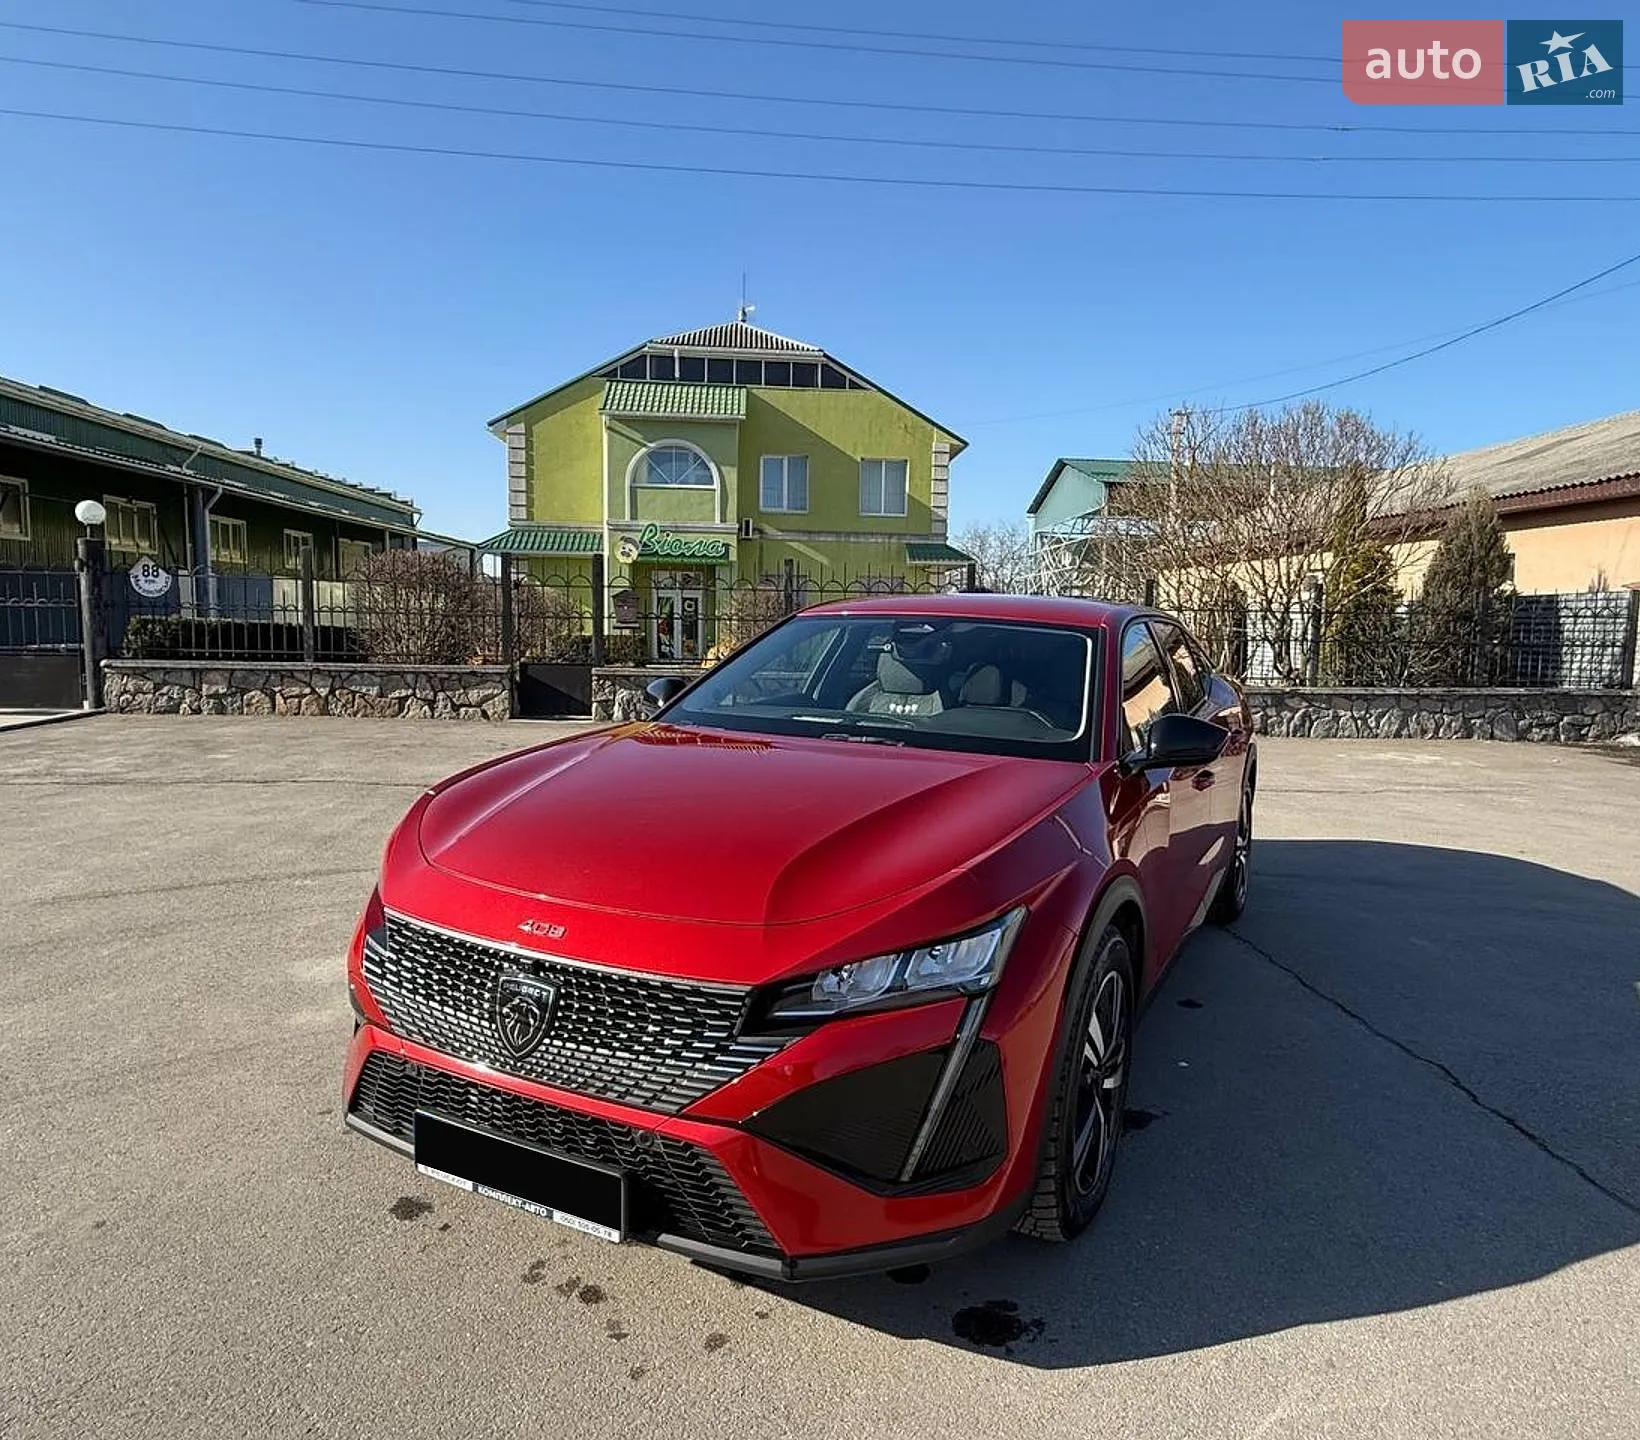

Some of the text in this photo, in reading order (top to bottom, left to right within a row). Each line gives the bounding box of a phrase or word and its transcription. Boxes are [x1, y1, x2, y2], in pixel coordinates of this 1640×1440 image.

[639, 522, 726, 557] Віола
[142, 563, 160, 579] 88
[517, 919, 567, 939] 408
